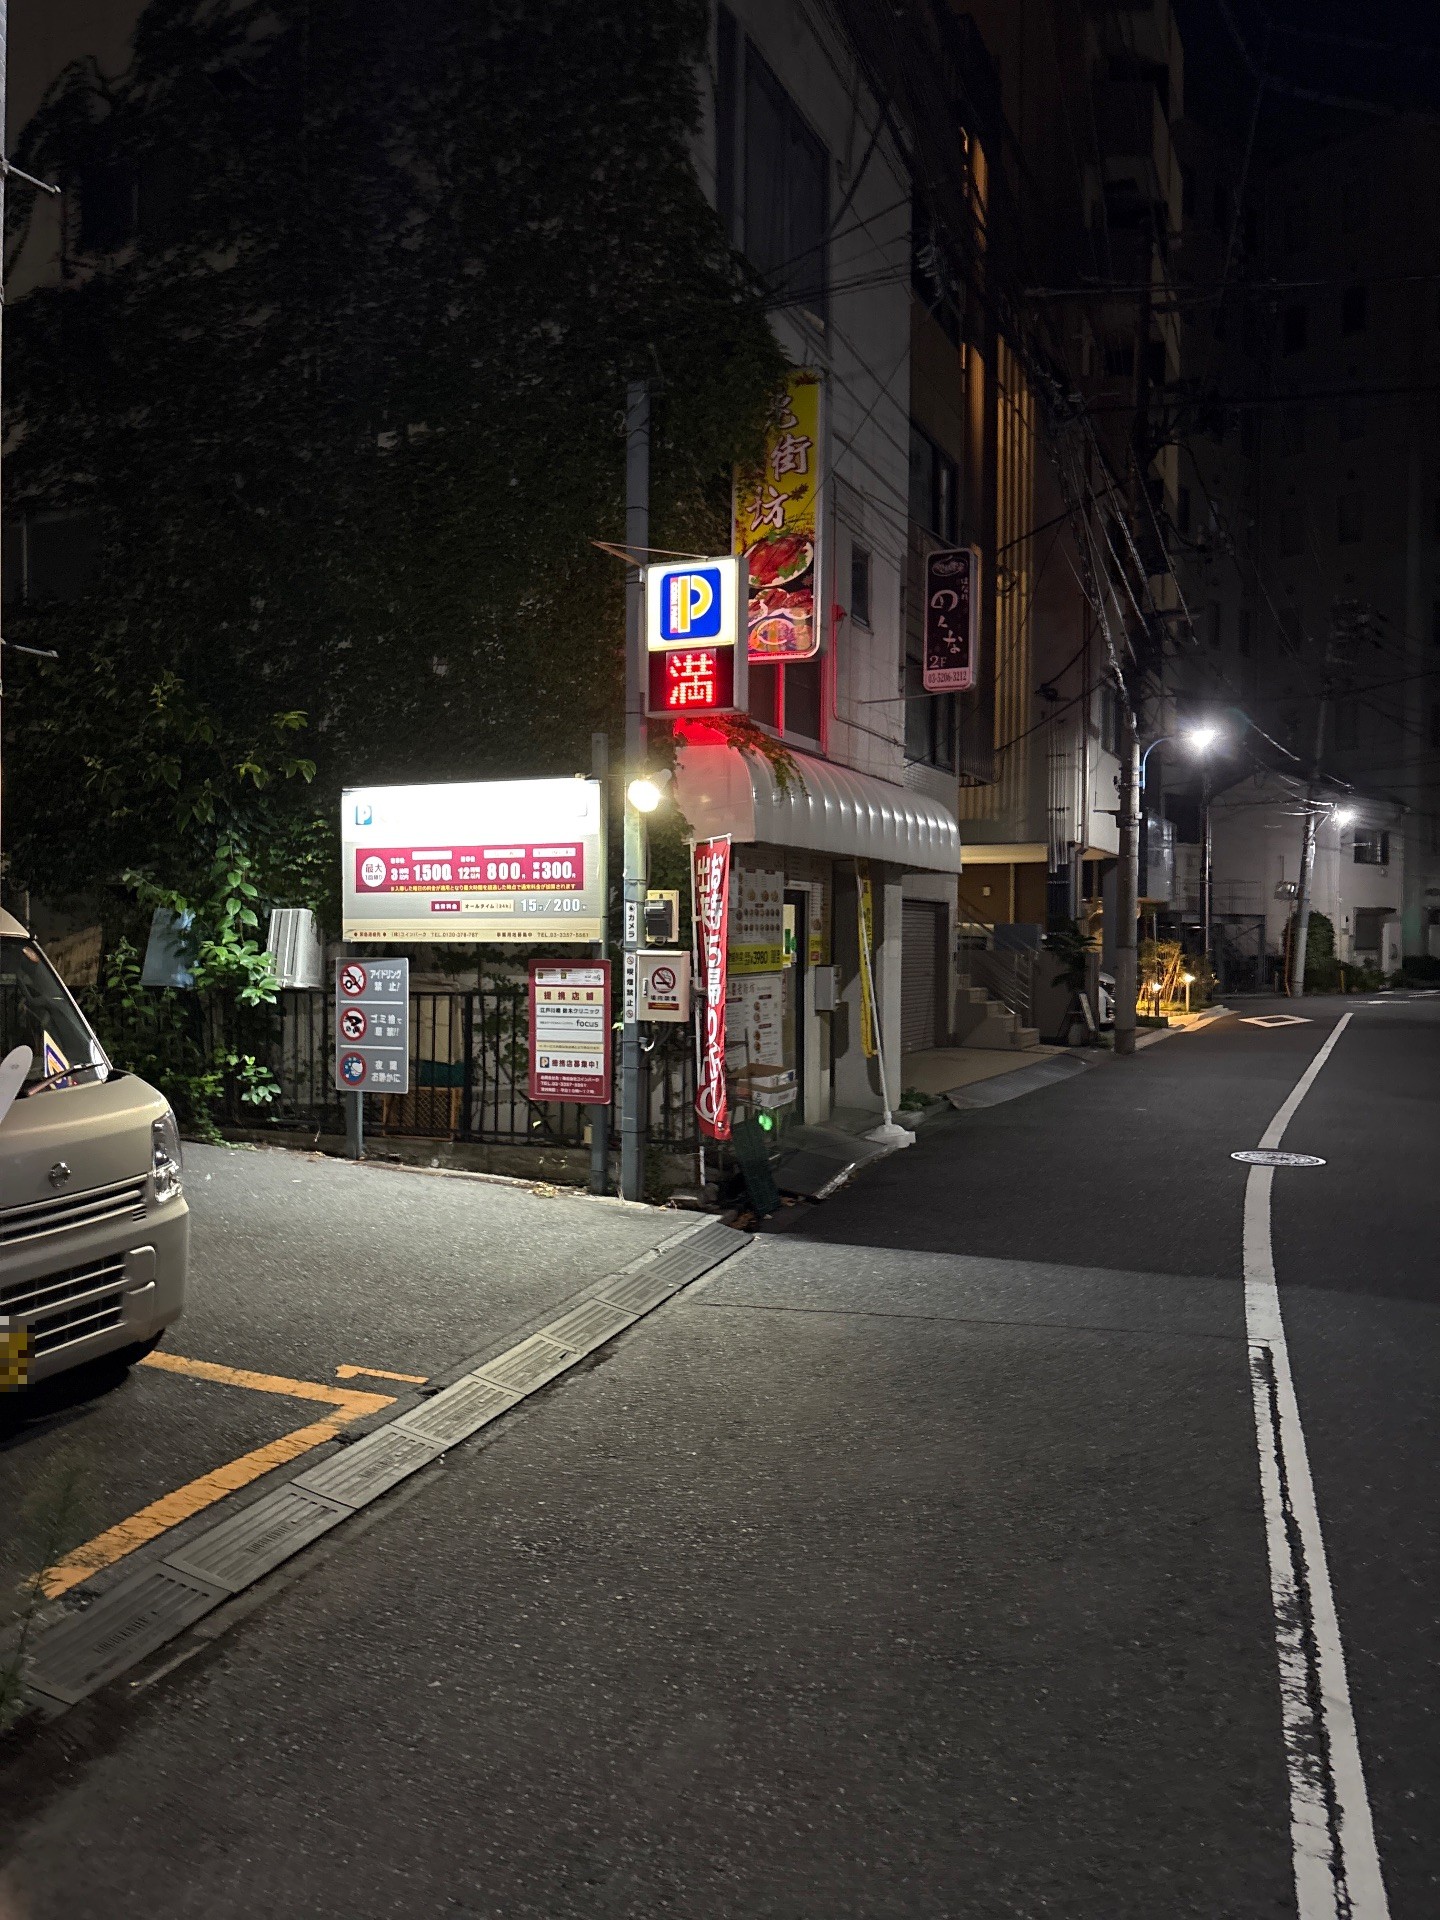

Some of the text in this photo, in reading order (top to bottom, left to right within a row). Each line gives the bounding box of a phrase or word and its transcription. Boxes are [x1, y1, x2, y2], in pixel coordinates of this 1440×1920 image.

[670, 653, 713, 704] 満
[366, 864, 382, 873] 最大
[369, 970, 401, 979] アイドリング
[576, 1019, 599, 1028] focus
